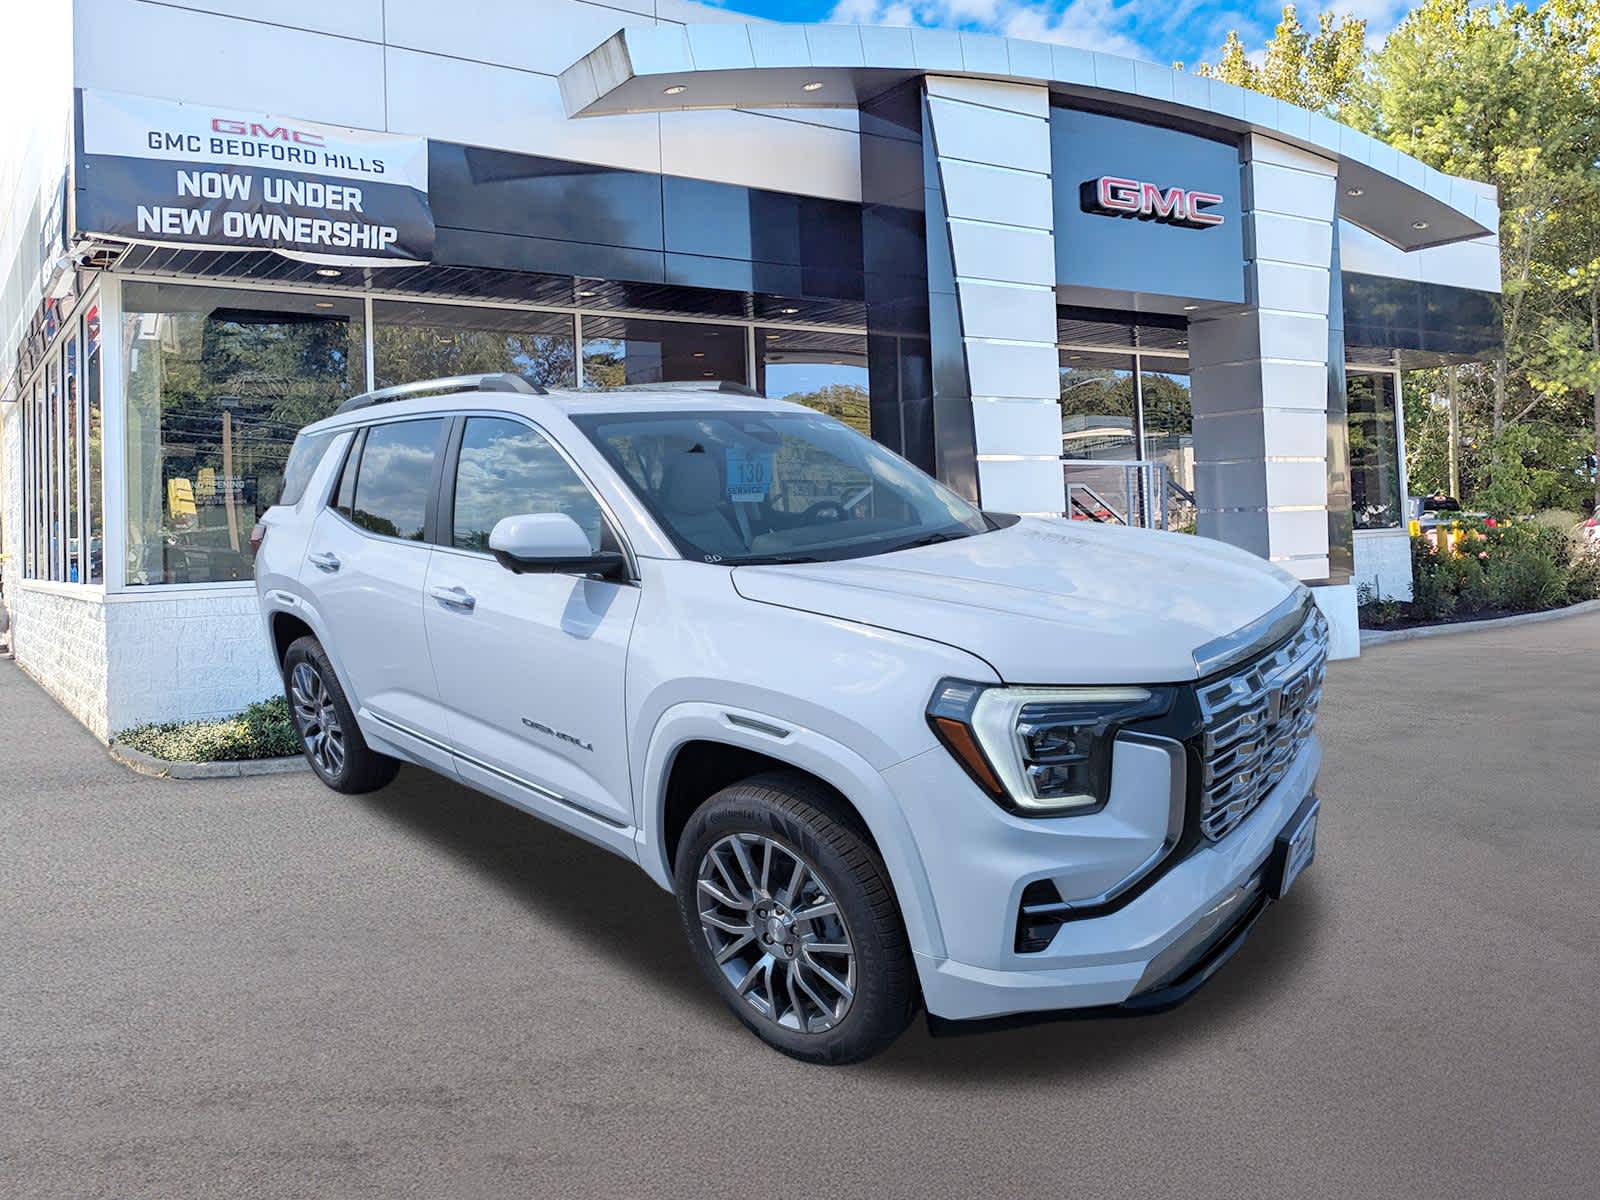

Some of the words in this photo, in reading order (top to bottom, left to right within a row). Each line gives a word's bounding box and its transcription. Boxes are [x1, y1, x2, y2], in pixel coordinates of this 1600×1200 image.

[148, 131, 201, 152] GMC
[210, 138, 318, 166] BEDFORD
[324, 154, 385, 174] HILLS
[210, 117, 326, 148] GMC
[176, 170, 252, 201] NOW
[263, 177, 364, 213] UNDER
[1096, 175, 1225, 225] GMC
[136, 205, 211, 236] NEW
[223, 211, 398, 250] OWNERSHIP
[727, 486, 763, 495] SERVICE
